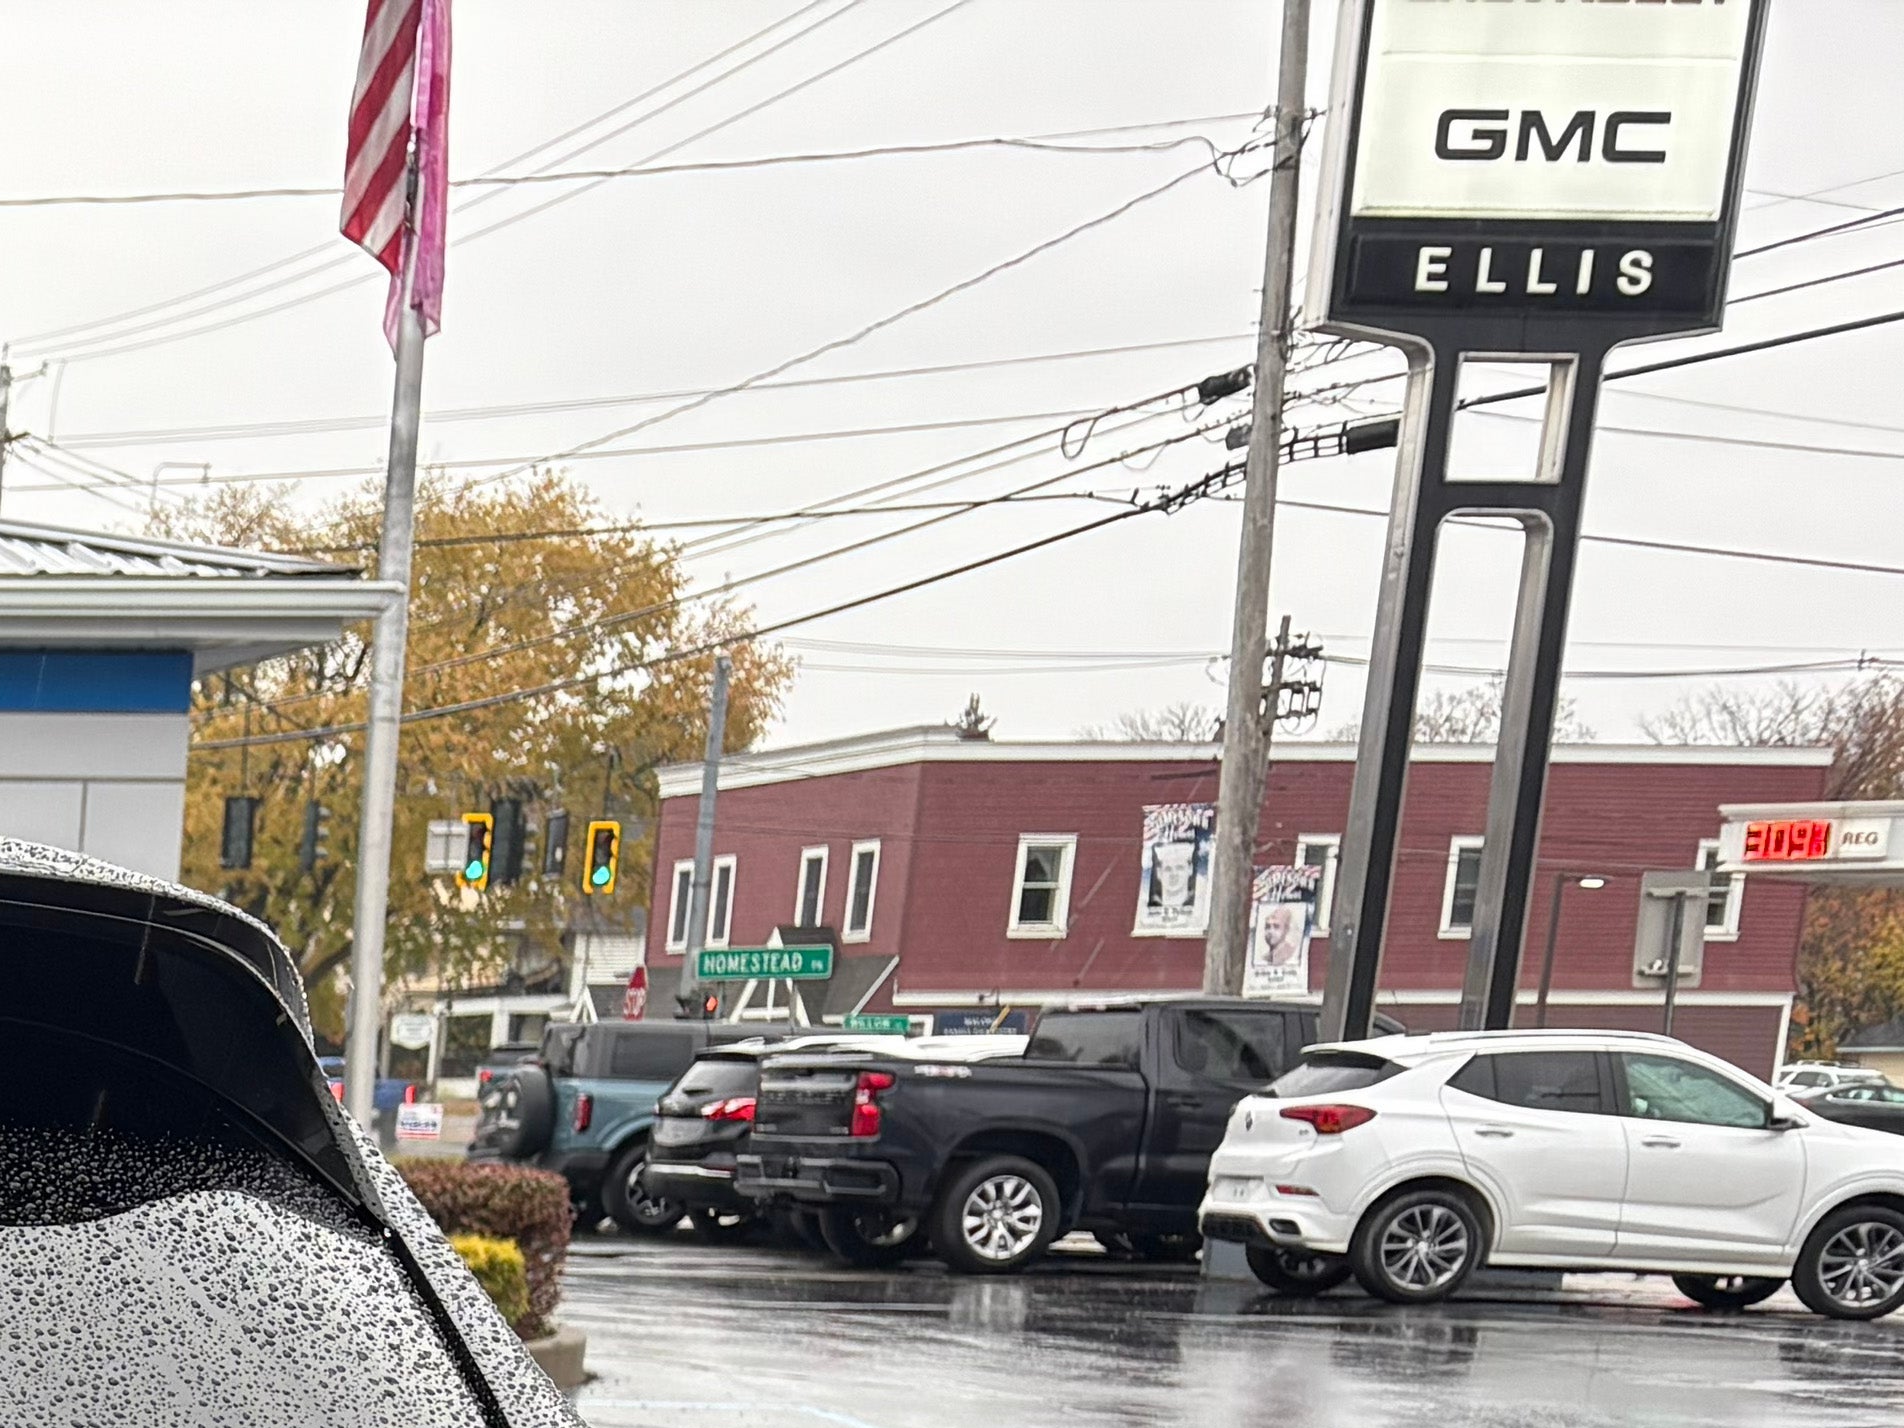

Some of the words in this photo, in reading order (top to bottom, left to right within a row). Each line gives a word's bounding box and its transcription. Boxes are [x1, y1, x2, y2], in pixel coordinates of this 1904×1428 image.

[1434, 108, 1672, 164] GMC
[1413, 245, 1655, 296] ELLIS
[703, 951, 804, 975] HOMESTEAD
